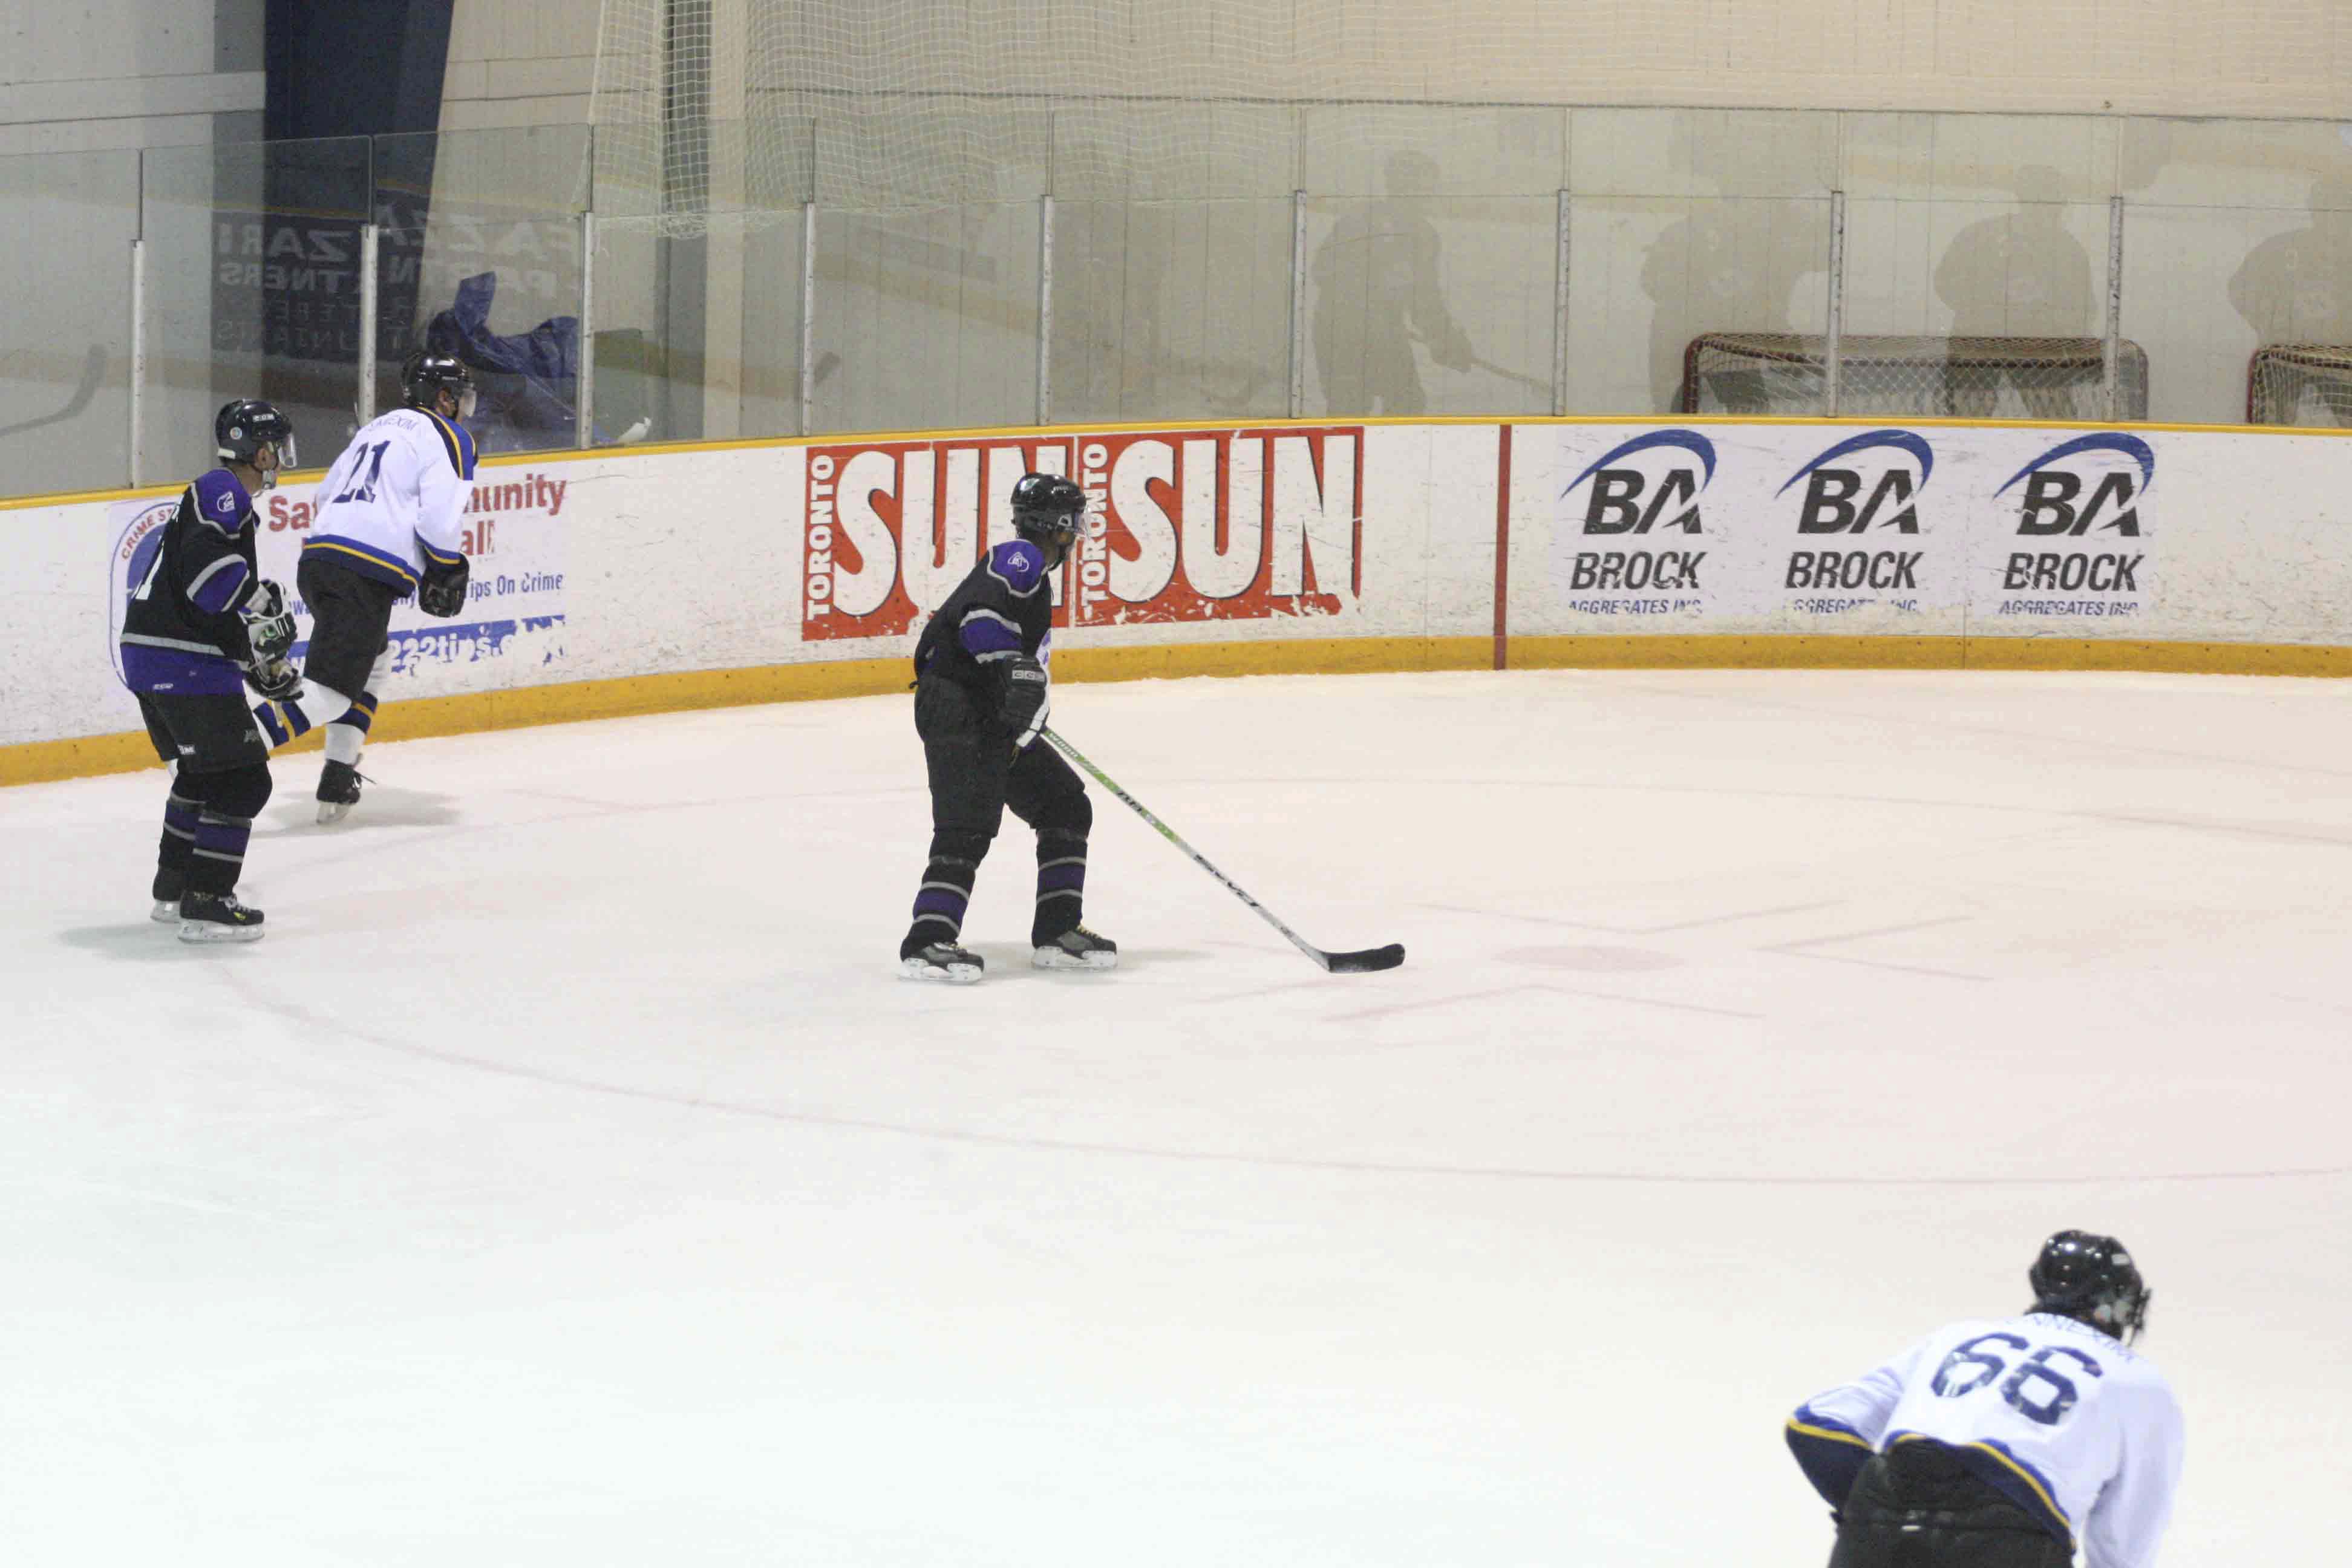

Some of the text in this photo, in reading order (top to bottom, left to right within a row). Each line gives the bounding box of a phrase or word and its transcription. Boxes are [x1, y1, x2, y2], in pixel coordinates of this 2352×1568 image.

[332, 440, 391, 504] 21
[1582, 469, 1702, 535] BA
[1798, 469, 1919, 535] BA
[2016, 471, 2141, 537] BA
[806, 454, 835, 621] TORONTO
[1081, 443, 1108, 619] TORONTO
[1108, 434, 1356, 604] SUN
[497, 575, 515, 595] On
[521, 572, 563, 593] Crime
[1570, 551, 1707, 590] BROCK
[1785, 550, 1924, 589] BROCK
[2003, 552, 2145, 591] BROCK
[1999, 600, 2105, 615] AGGREGATES
[1931, 1332, 2103, 1426] 66
